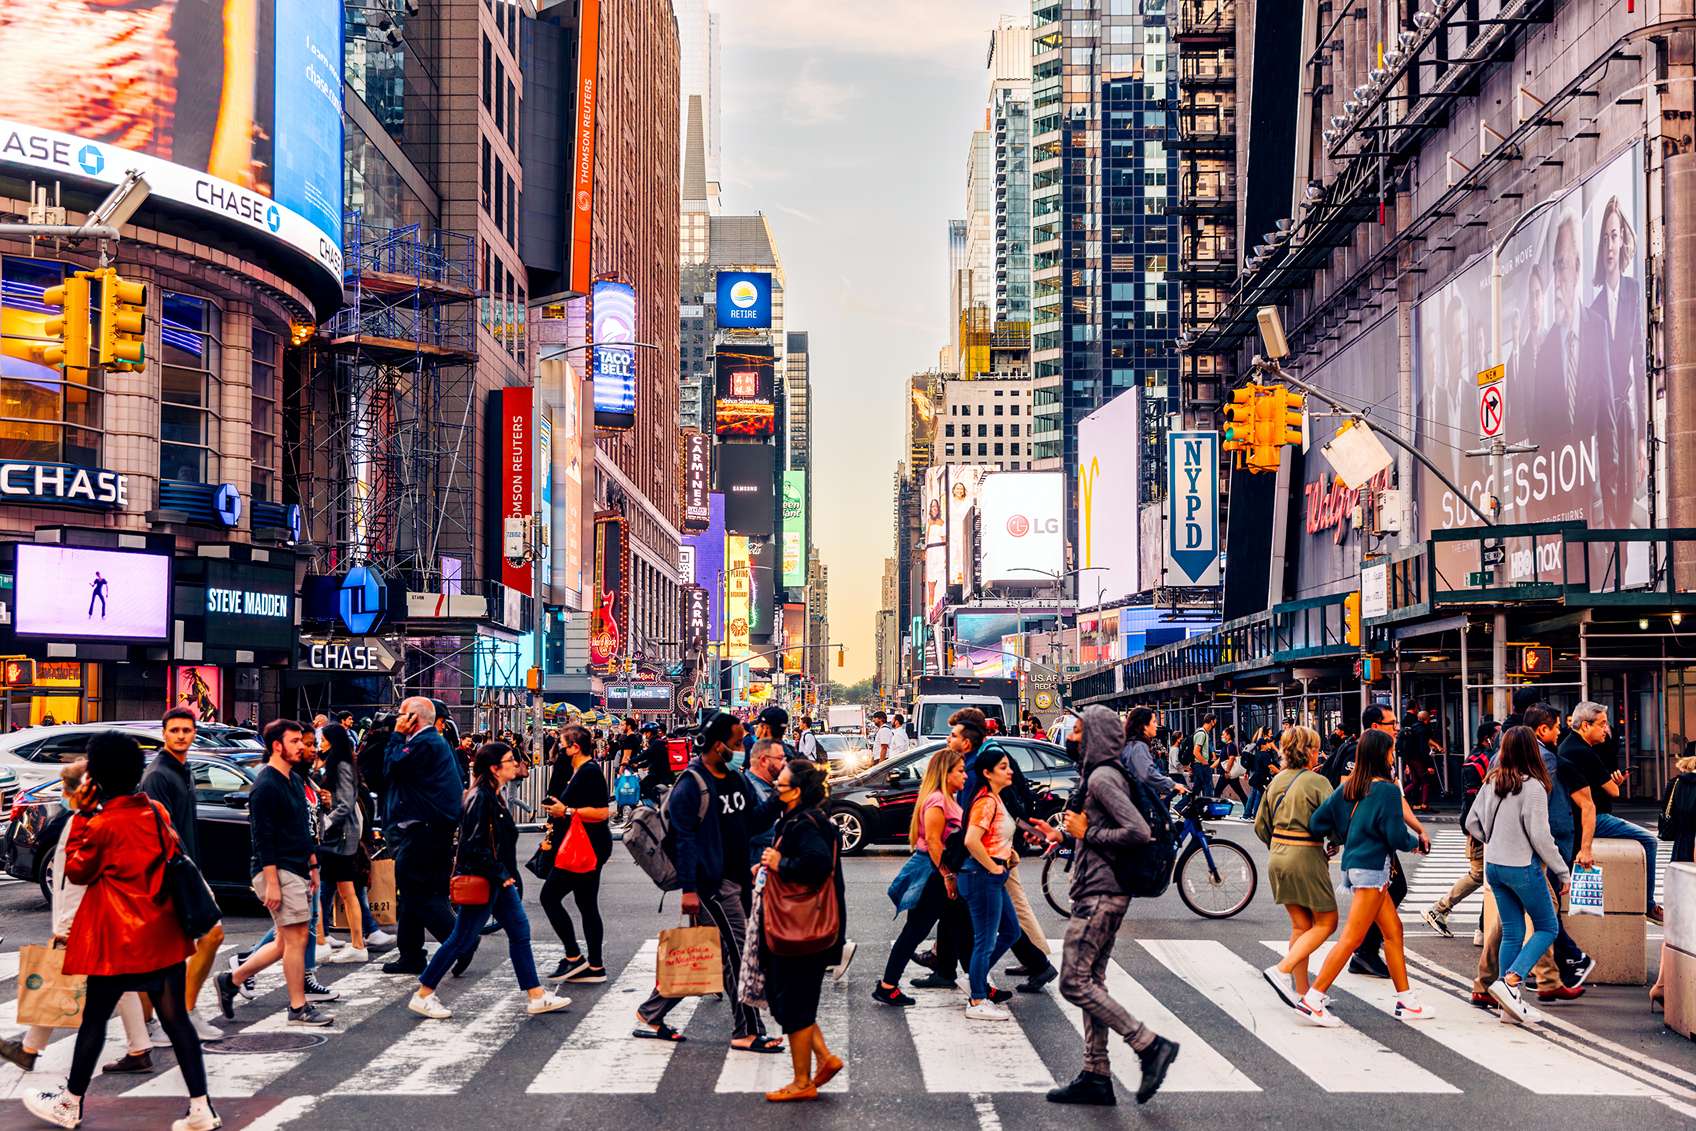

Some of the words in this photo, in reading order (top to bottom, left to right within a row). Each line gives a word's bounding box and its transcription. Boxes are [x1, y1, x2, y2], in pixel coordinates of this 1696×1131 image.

[583, 79, 593, 127] REUTERS
[580, 130, 591, 184] THOMSON
[195, 179, 265, 225] CHASE
[730, 309, 757, 319] RETIRE
[599, 351, 630, 365] TACO
[601, 363, 632, 376] BELL
[512, 415, 523, 472] REUTERS
[0, 463, 128, 505] CHASE
[512, 475, 523, 519] OMSON
[1184, 440, 1203, 549] NYPD
[1034, 518, 1059, 534] LG
[208, 587, 242, 613] STEVE
[244, 591, 288, 617] MADDEN
[311, 644, 378, 670] CHASE
